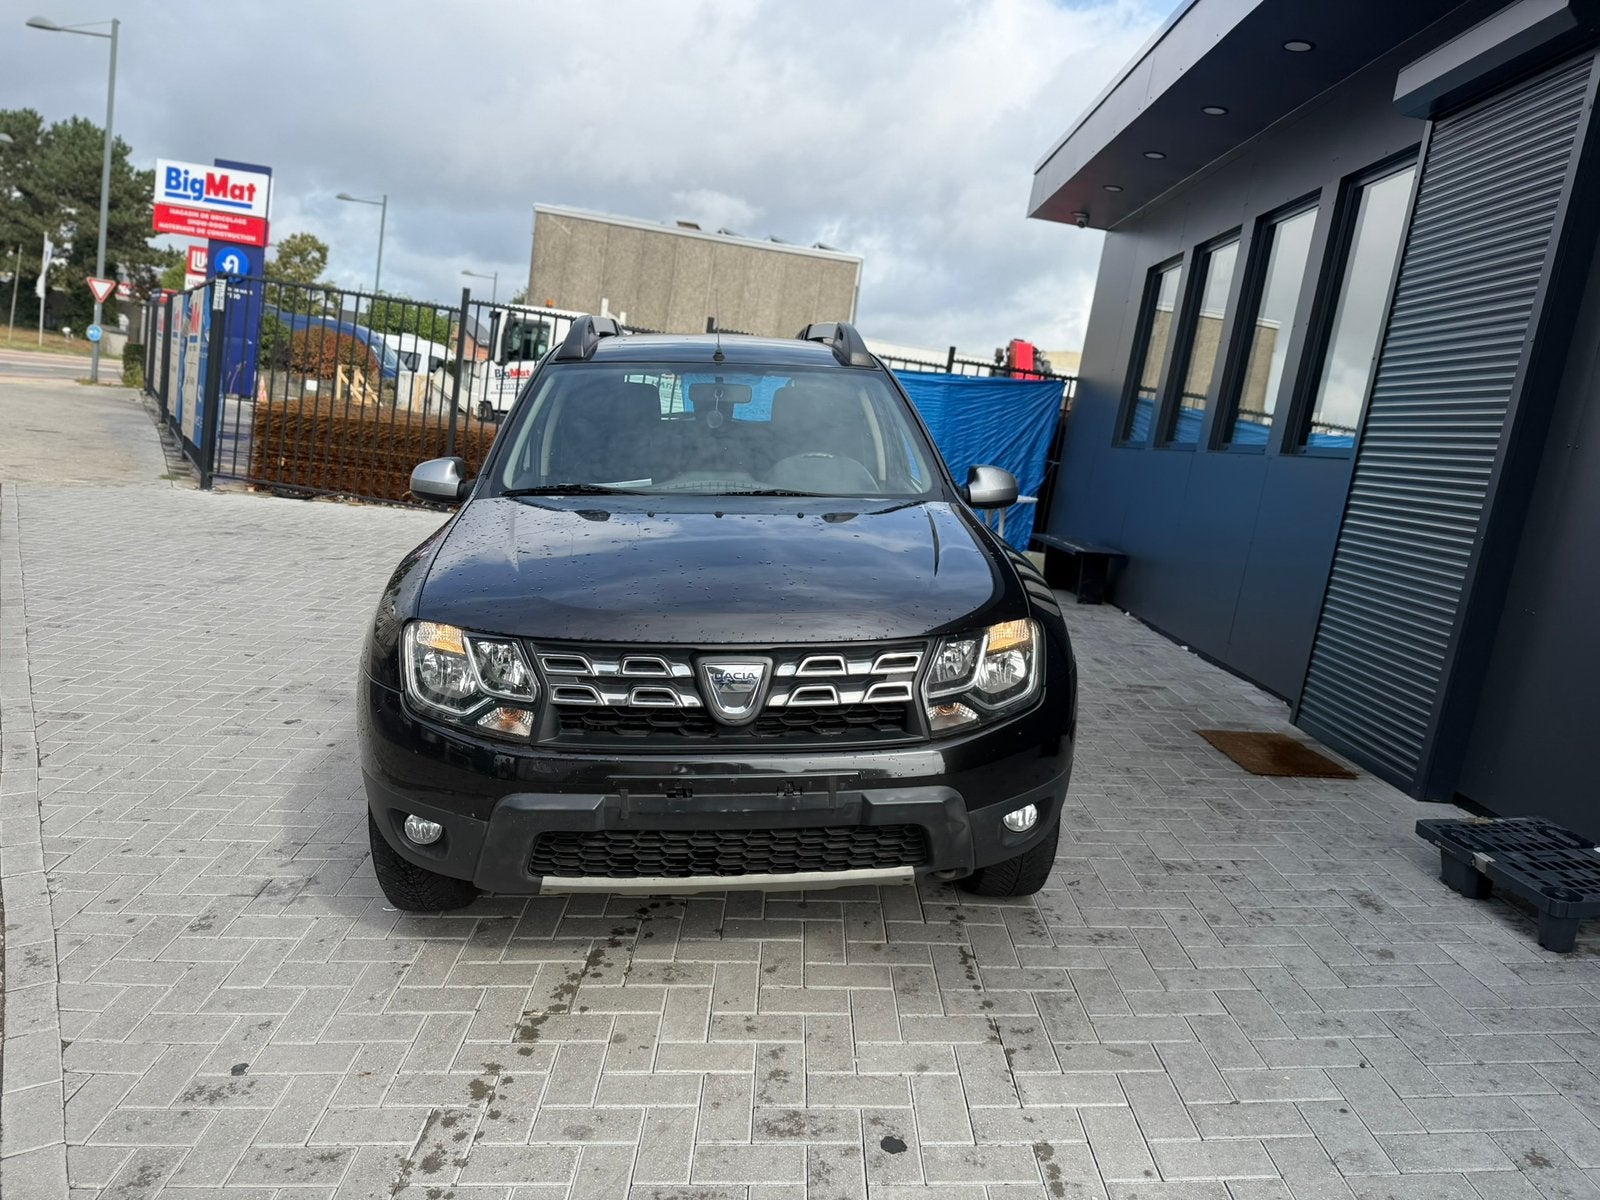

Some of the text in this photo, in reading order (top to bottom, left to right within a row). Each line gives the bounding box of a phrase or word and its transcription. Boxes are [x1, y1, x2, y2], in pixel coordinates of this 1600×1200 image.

[165, 166, 256, 202] BigMat
[206, 229, 256, 242] CONSTRUCTION
[495, 368, 530, 380] BgMat
[714, 672, 757, 680] DACIA
